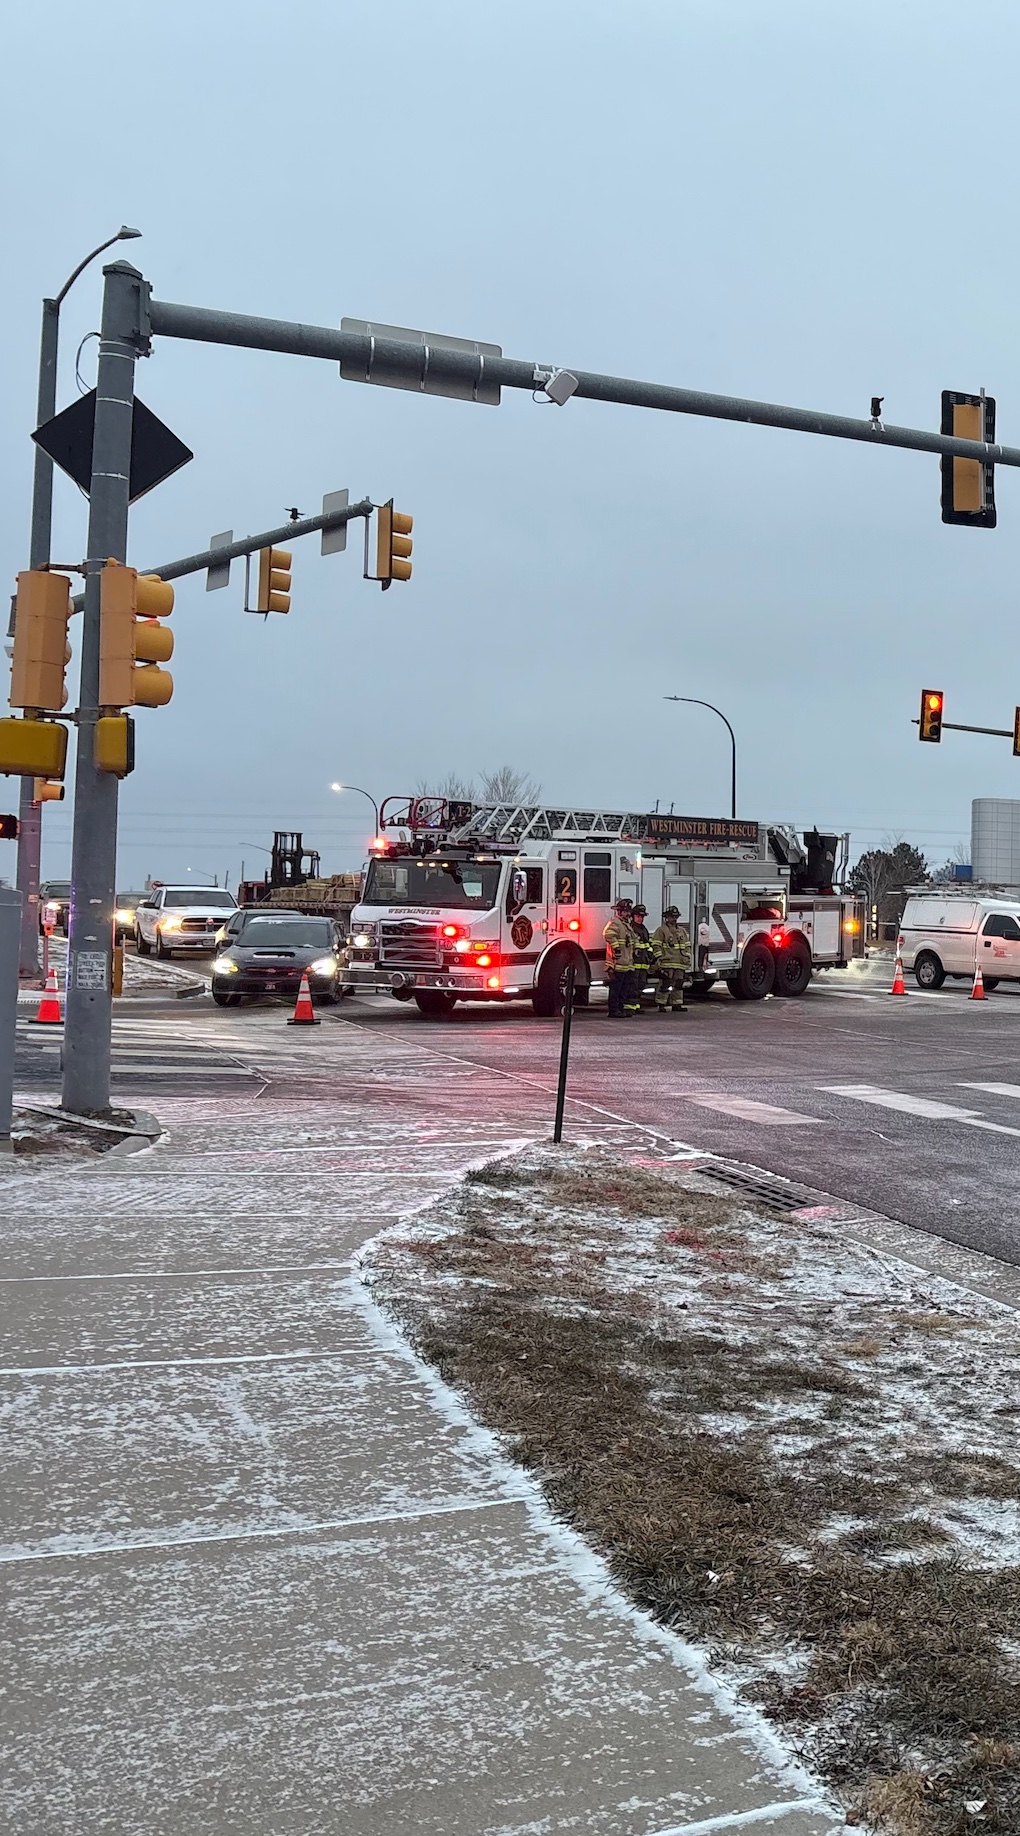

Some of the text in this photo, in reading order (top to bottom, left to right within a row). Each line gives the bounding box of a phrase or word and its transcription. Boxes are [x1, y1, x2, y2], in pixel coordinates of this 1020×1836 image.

[457, 805, 471, 818] T-2
[651, 819, 757, 836] WESTMINSTER FIRE-RESCUE
[561, 876, 571, 897] 2
[360, 952, 374, 960] T-2
